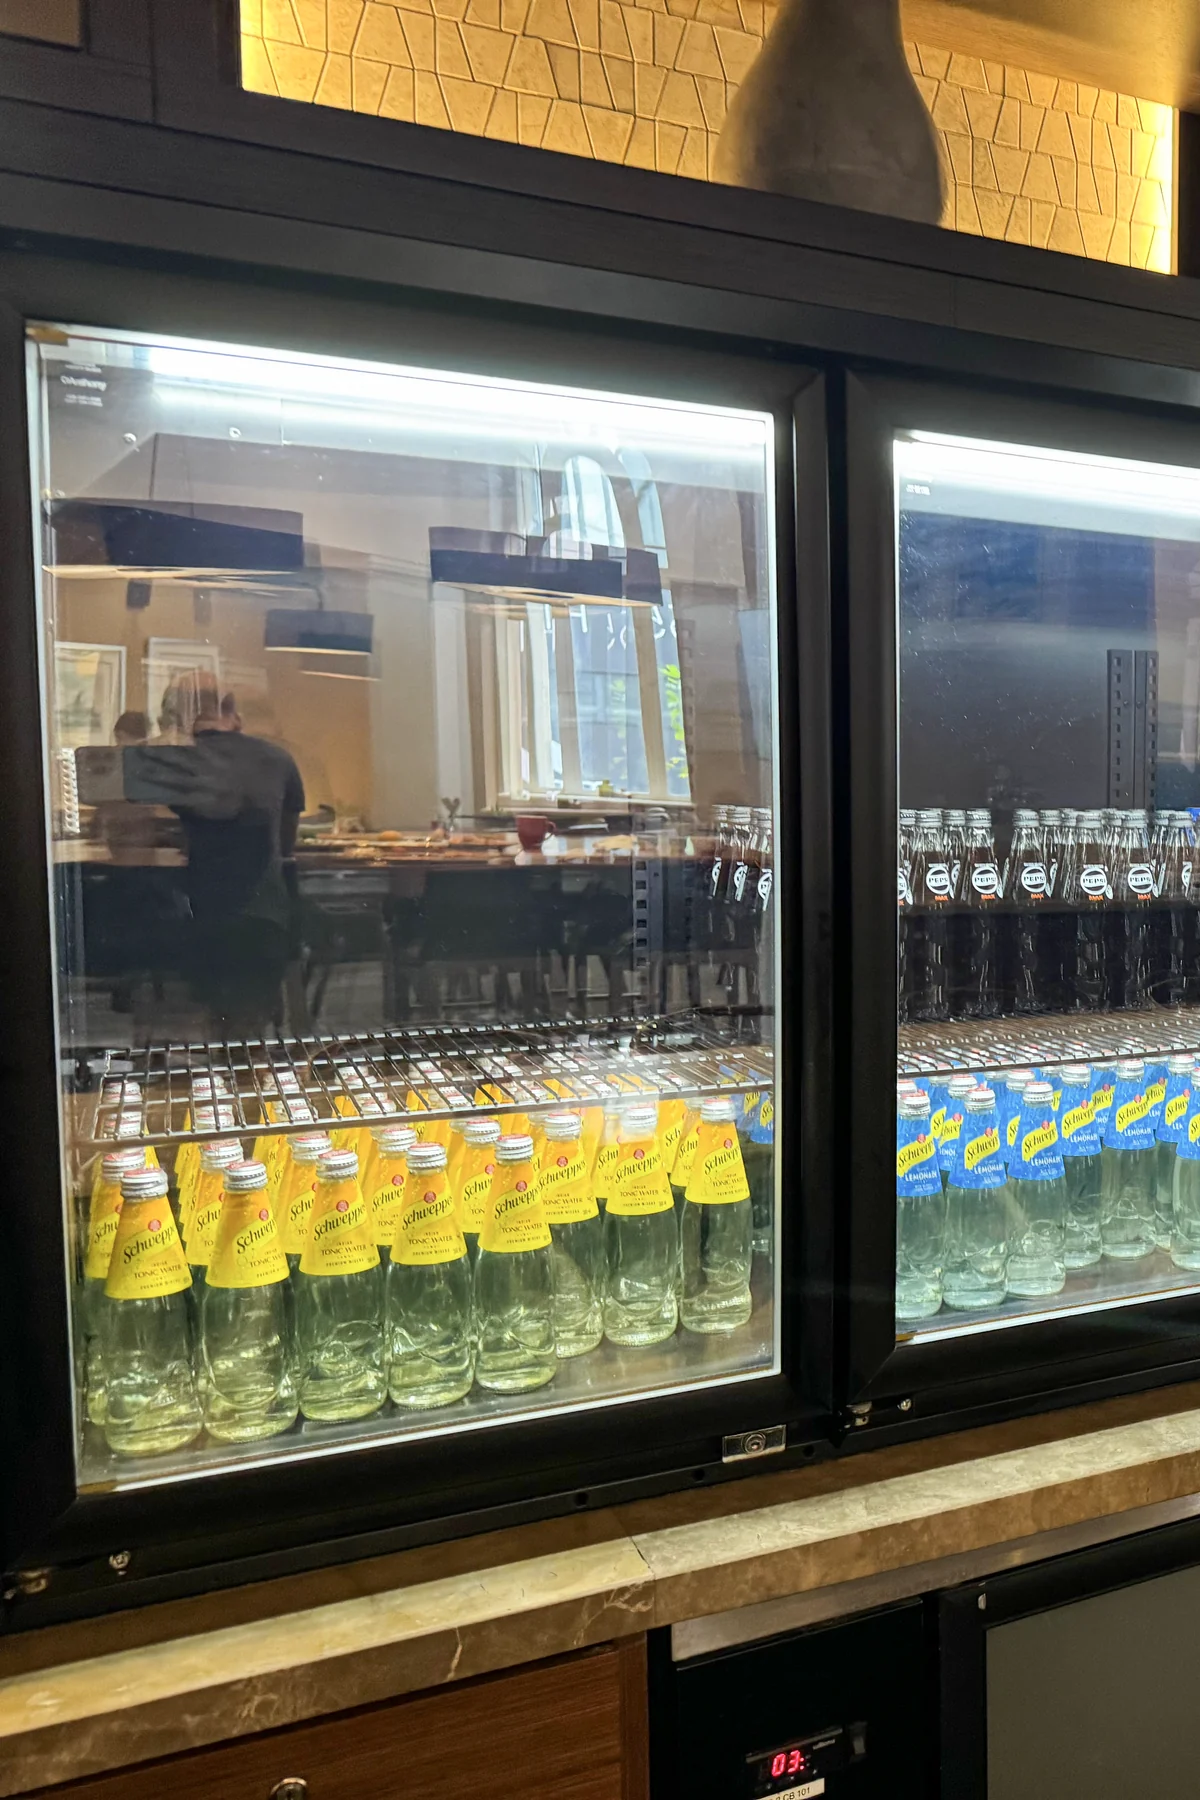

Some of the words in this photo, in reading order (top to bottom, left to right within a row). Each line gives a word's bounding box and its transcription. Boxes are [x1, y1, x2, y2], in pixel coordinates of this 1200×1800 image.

[470, 1207, 485, 1215] TON
[502, 1225, 523, 1234] TONIC
[408, 1236, 430, 1245] TONIC
[431, 1235, 453, 1243] WATER
[320, 1247, 343, 1257] TONIC
[345, 1243, 367, 1254] WATER
[134, 1269, 159, 1280] TONIC
[797, 1787, 810, 1797] 101
